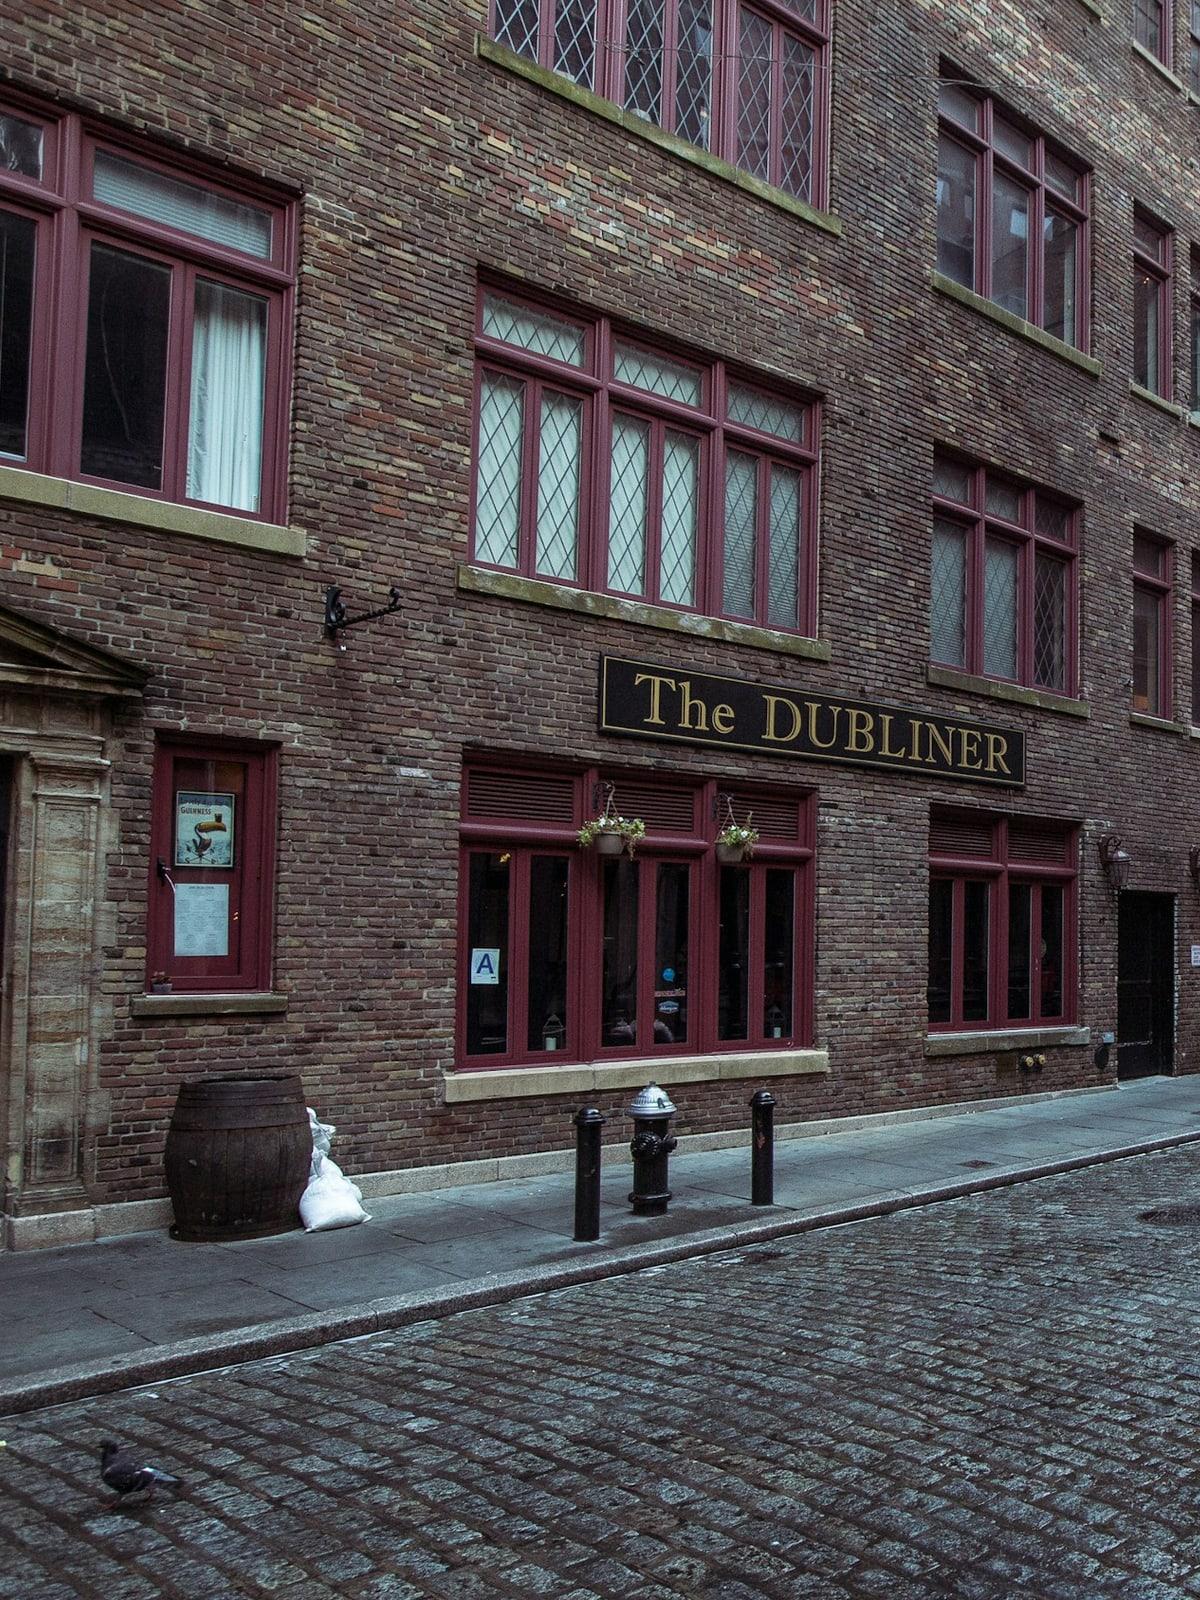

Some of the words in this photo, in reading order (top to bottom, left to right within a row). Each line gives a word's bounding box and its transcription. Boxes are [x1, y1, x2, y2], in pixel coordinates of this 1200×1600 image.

[634, 673, 735, 734] The
[761, 695, 1011, 774] DUBLINER
[476, 953, 494, 974] A
